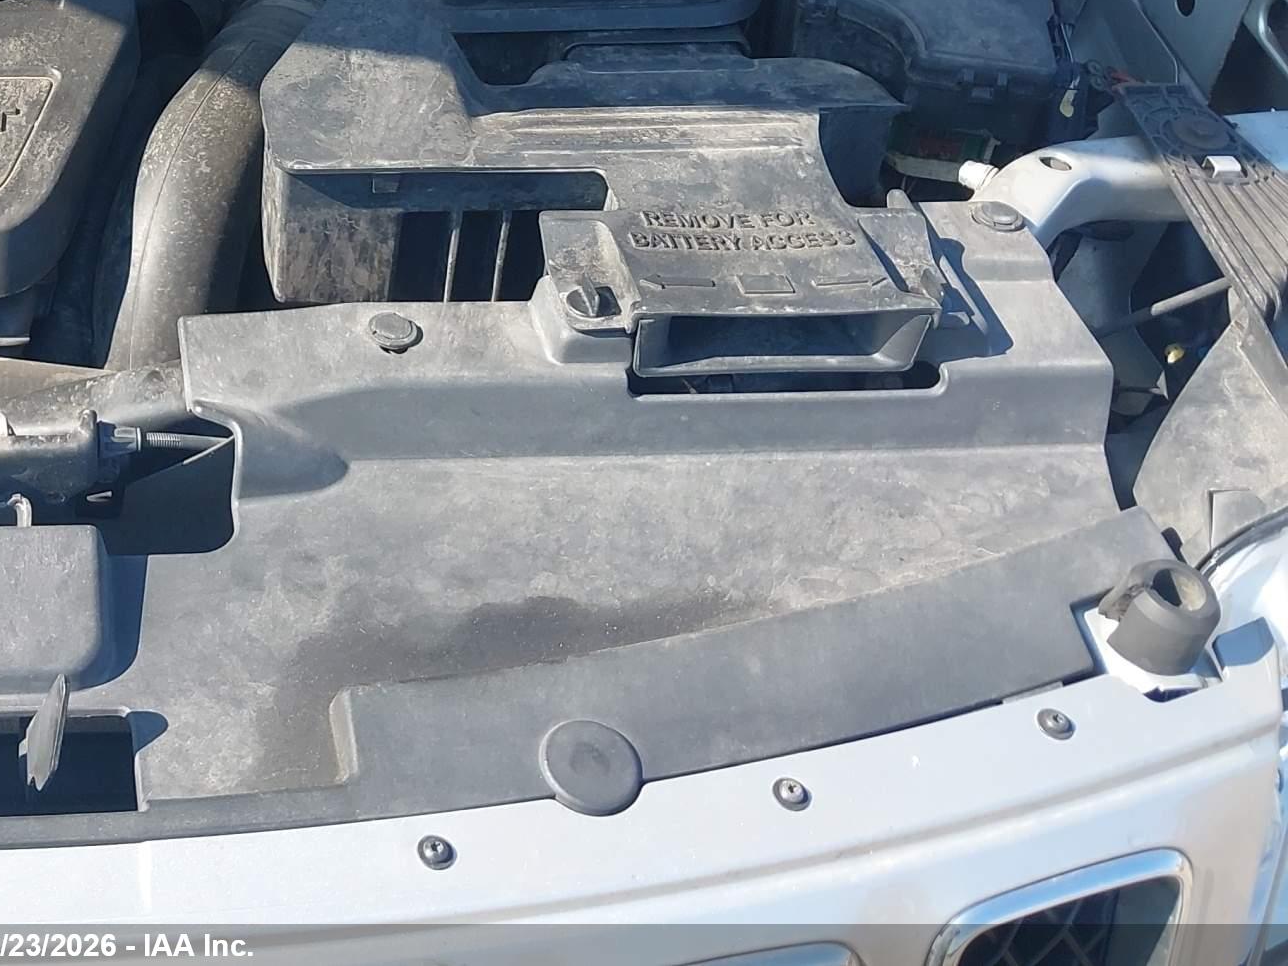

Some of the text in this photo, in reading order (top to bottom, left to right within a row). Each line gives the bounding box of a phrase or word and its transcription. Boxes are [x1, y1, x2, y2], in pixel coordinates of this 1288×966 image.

[639, 209, 817, 231] REMOVE FOR
[627, 230, 858, 252] BATTERY ACCESS
